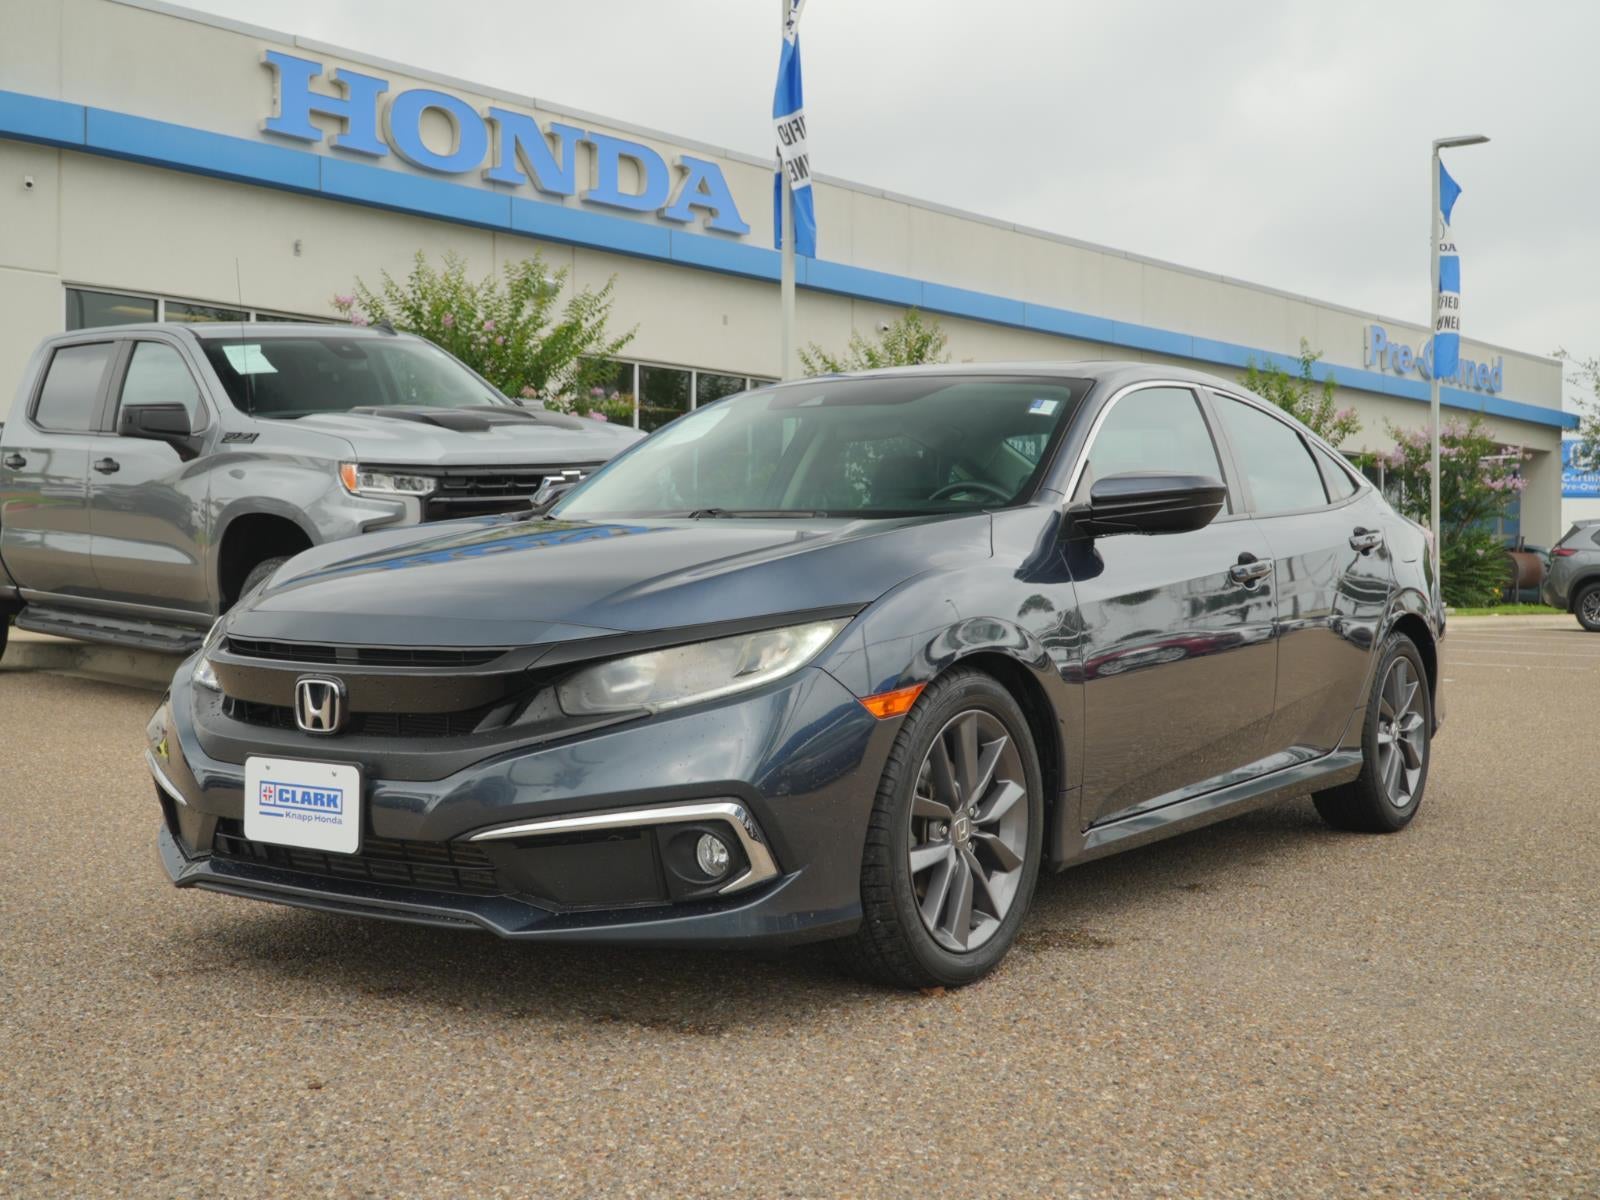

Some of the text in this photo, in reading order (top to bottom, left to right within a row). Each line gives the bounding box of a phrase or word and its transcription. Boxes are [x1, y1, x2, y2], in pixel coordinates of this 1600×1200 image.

[261, 50, 750, 236] HONDA
[1365, 324, 1503, 394] Pre-ned
[278, 788, 339, 808] CLARK
[285, 811, 343, 825] Knapp Honda
